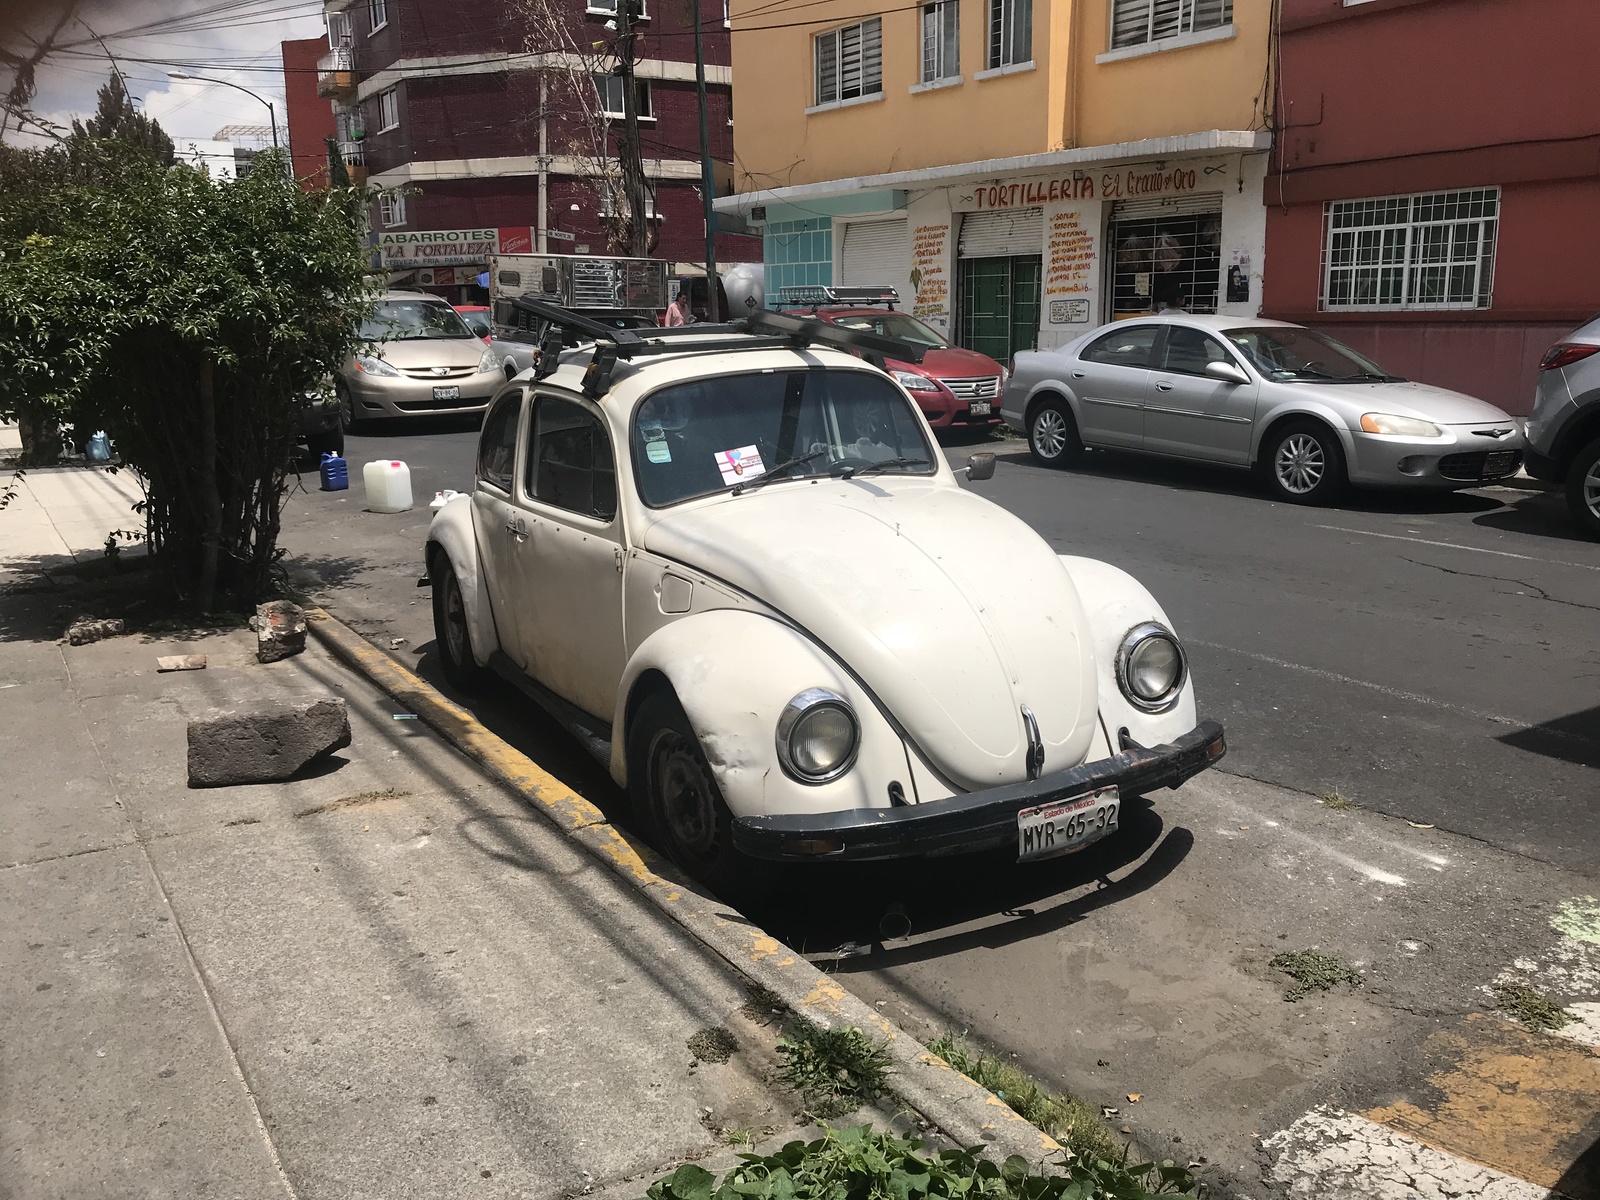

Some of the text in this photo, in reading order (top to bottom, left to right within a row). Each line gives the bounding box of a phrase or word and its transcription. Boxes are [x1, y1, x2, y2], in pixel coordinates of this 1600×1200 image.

[1102, 173, 1122, 197] El
[1127, 170, 1160, 196] Grano
[1173, 168, 1196, 190] Oro
[1055, 213, 1074, 221] SOPES
[1053, 221, 1078, 230] TOTOPOS
[383, 230, 496, 244] ABARROTES
[1055, 230, 1088, 239] TOSTADAS
[502, 236, 529, 252] Victoria
[914, 248, 942, 258] TORTILLA
[384, 258, 418, 266] CERVEZA
[1043, 807, 1065, 820] Estado
[1065, 805, 1073, 814] de
[1073, 799, 1096, 811] México
[1023, 803, 1117, 853] MYR-65-32
